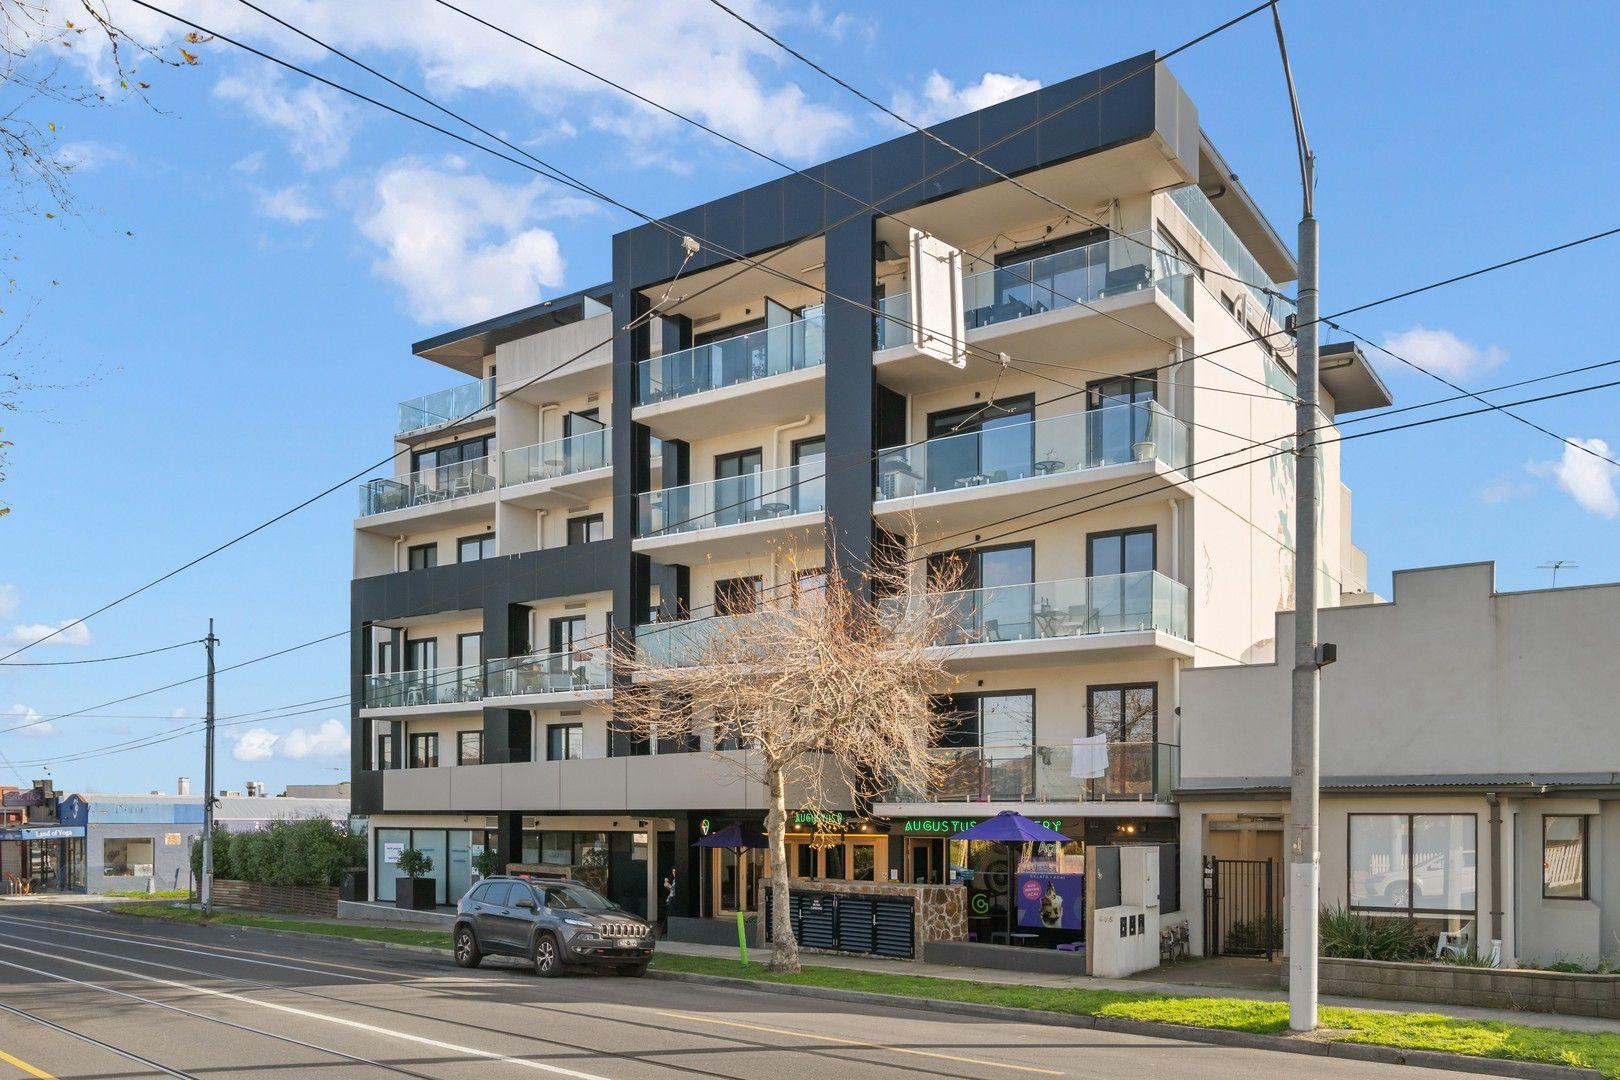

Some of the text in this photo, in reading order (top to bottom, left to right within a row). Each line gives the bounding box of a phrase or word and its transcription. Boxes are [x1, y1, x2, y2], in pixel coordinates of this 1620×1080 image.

[904, 820, 977, 832] AUGUSTUS
[35, 829, 72, 838] Land of Yoga
